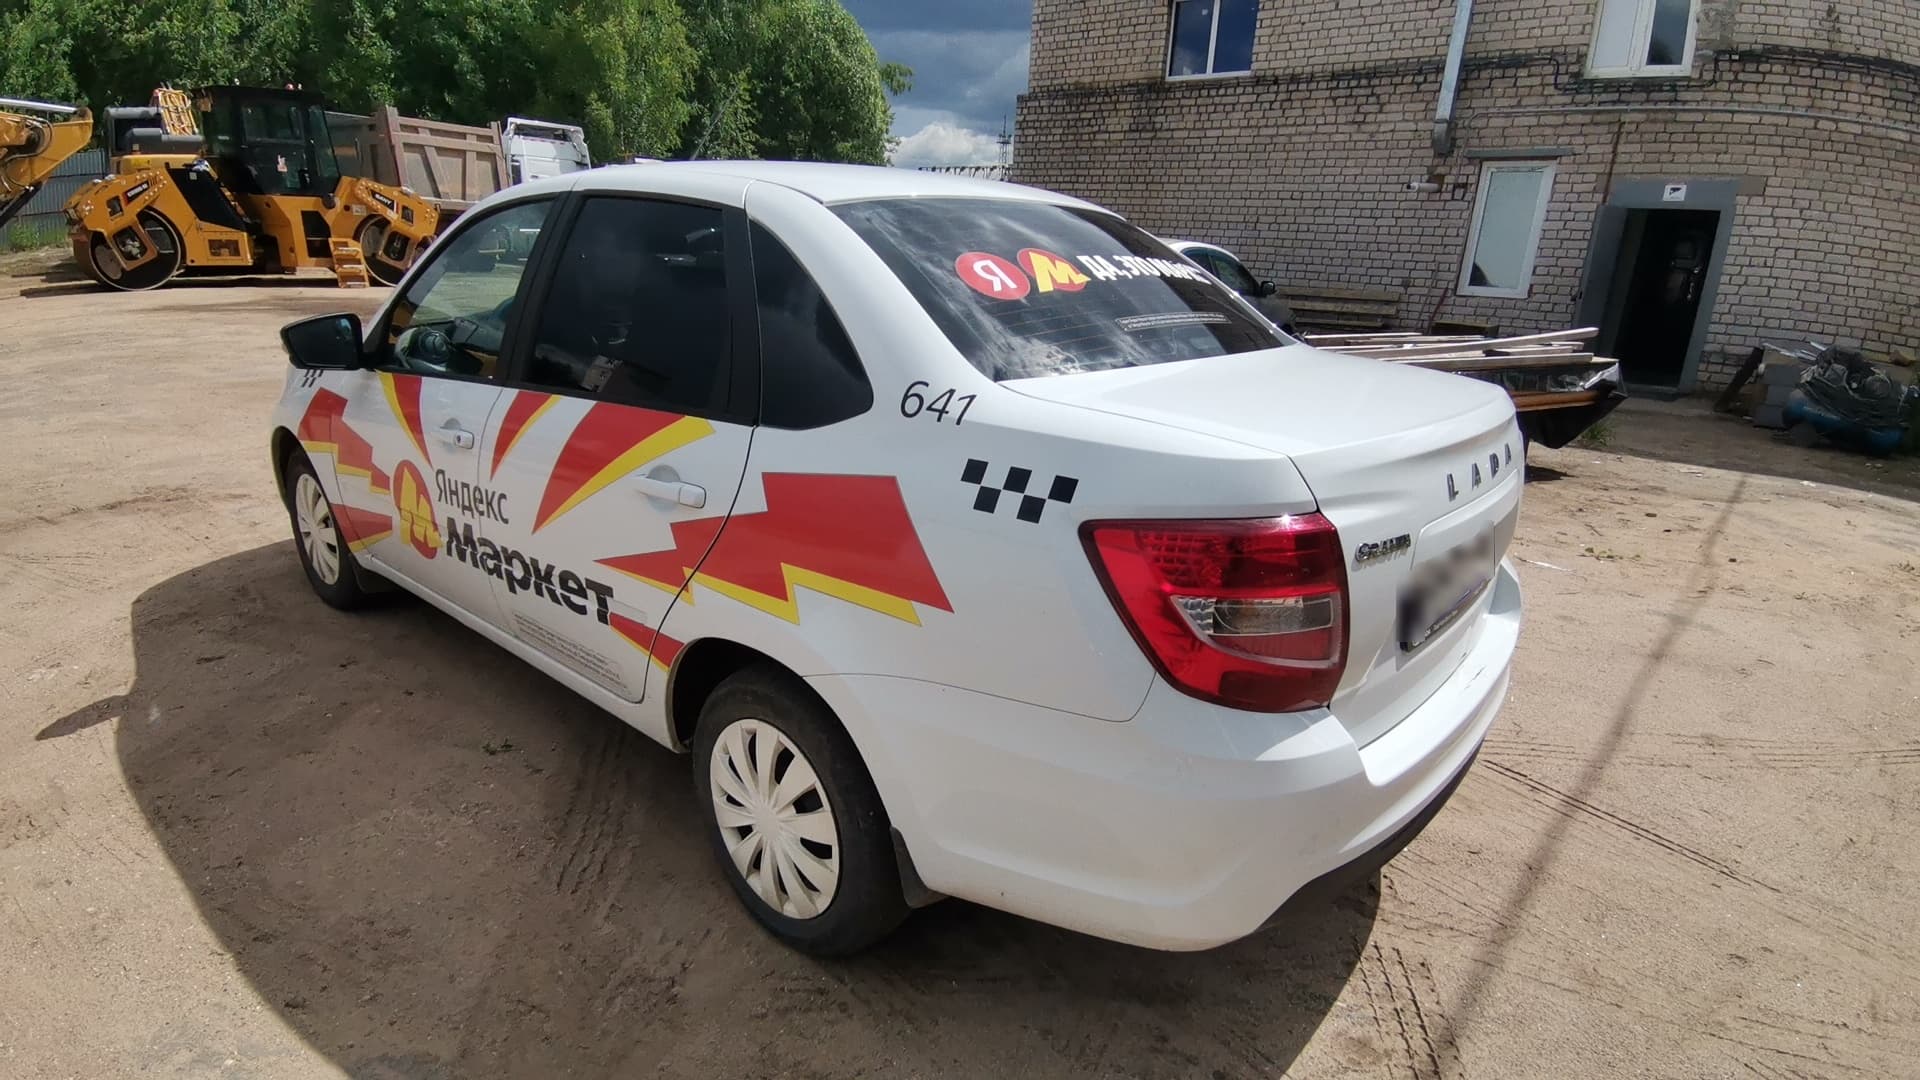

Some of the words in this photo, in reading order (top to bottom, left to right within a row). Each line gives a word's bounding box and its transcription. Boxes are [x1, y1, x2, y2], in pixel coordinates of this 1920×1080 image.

[972, 259, 1018, 292] Я
[900, 380, 977, 426] 641
[435, 468, 510, 525] Яндекс
[1446, 442, 1512, 502] LADA
[446, 516, 614, 627] Маркет
